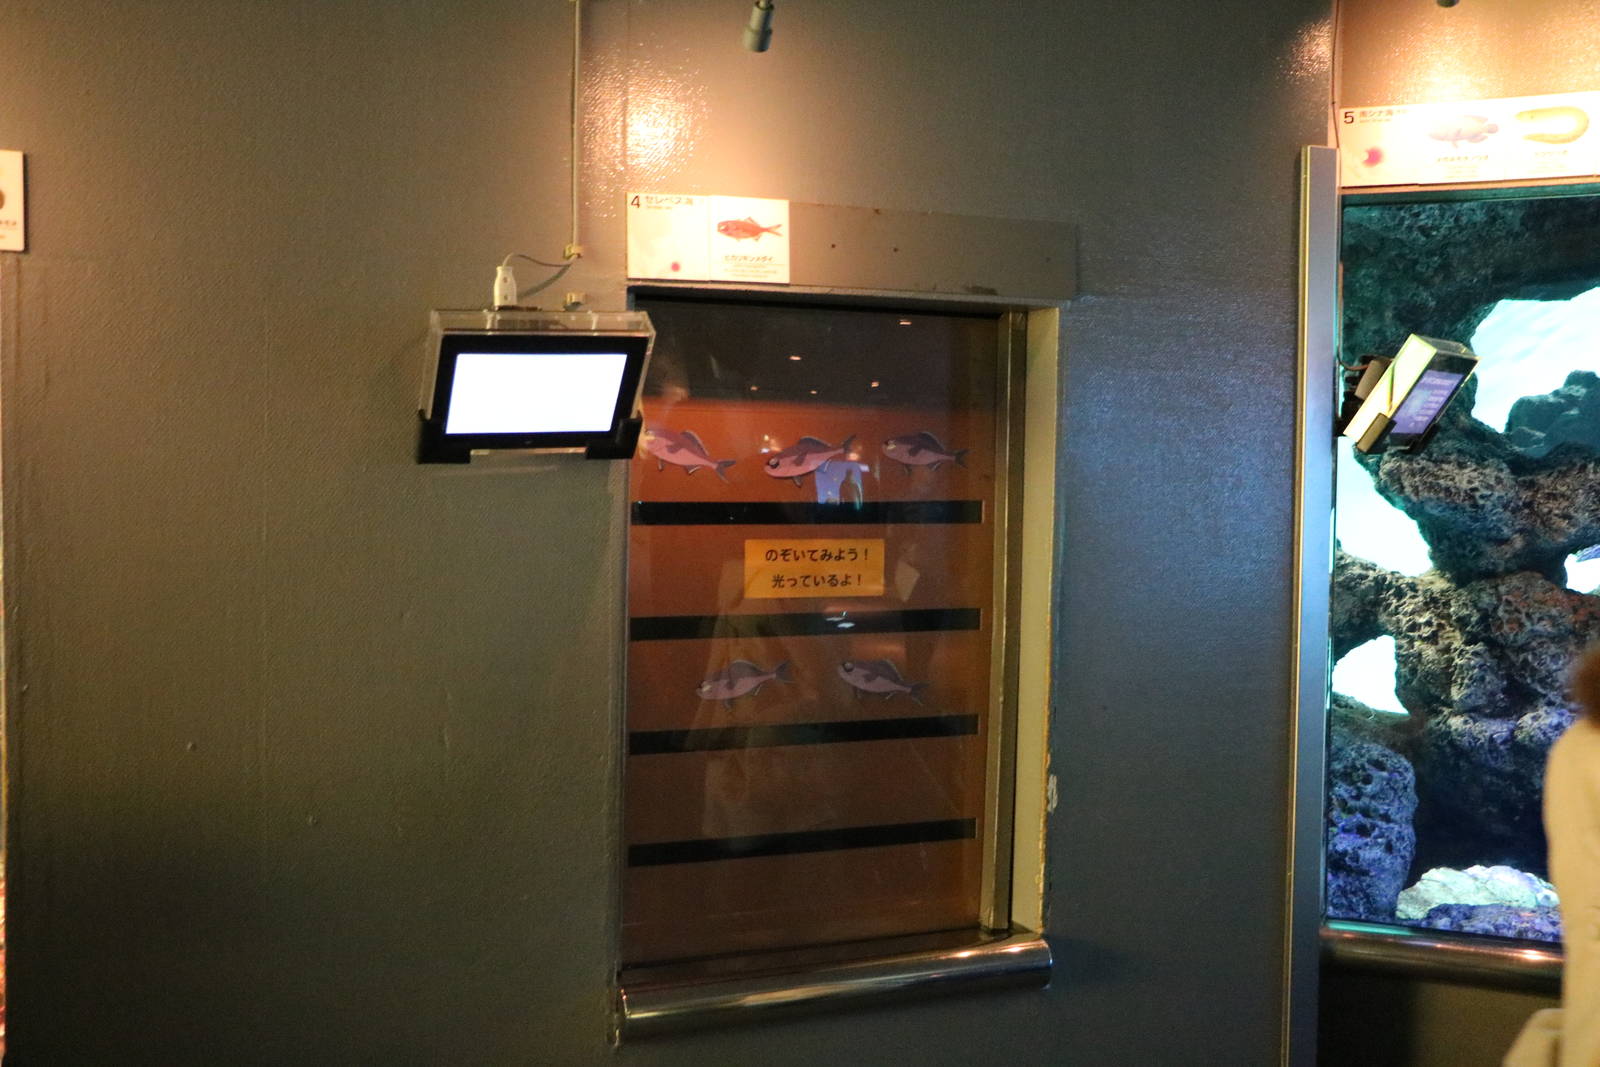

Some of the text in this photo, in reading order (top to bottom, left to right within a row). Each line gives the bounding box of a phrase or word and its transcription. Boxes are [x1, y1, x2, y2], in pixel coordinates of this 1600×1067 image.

[1343, 111, 1355, 124] 5
[630, 195, 641, 209] 4
[765, 548, 868, 562] のぞいてみよう！
[772, 573, 862, 588] 光っているよ！
